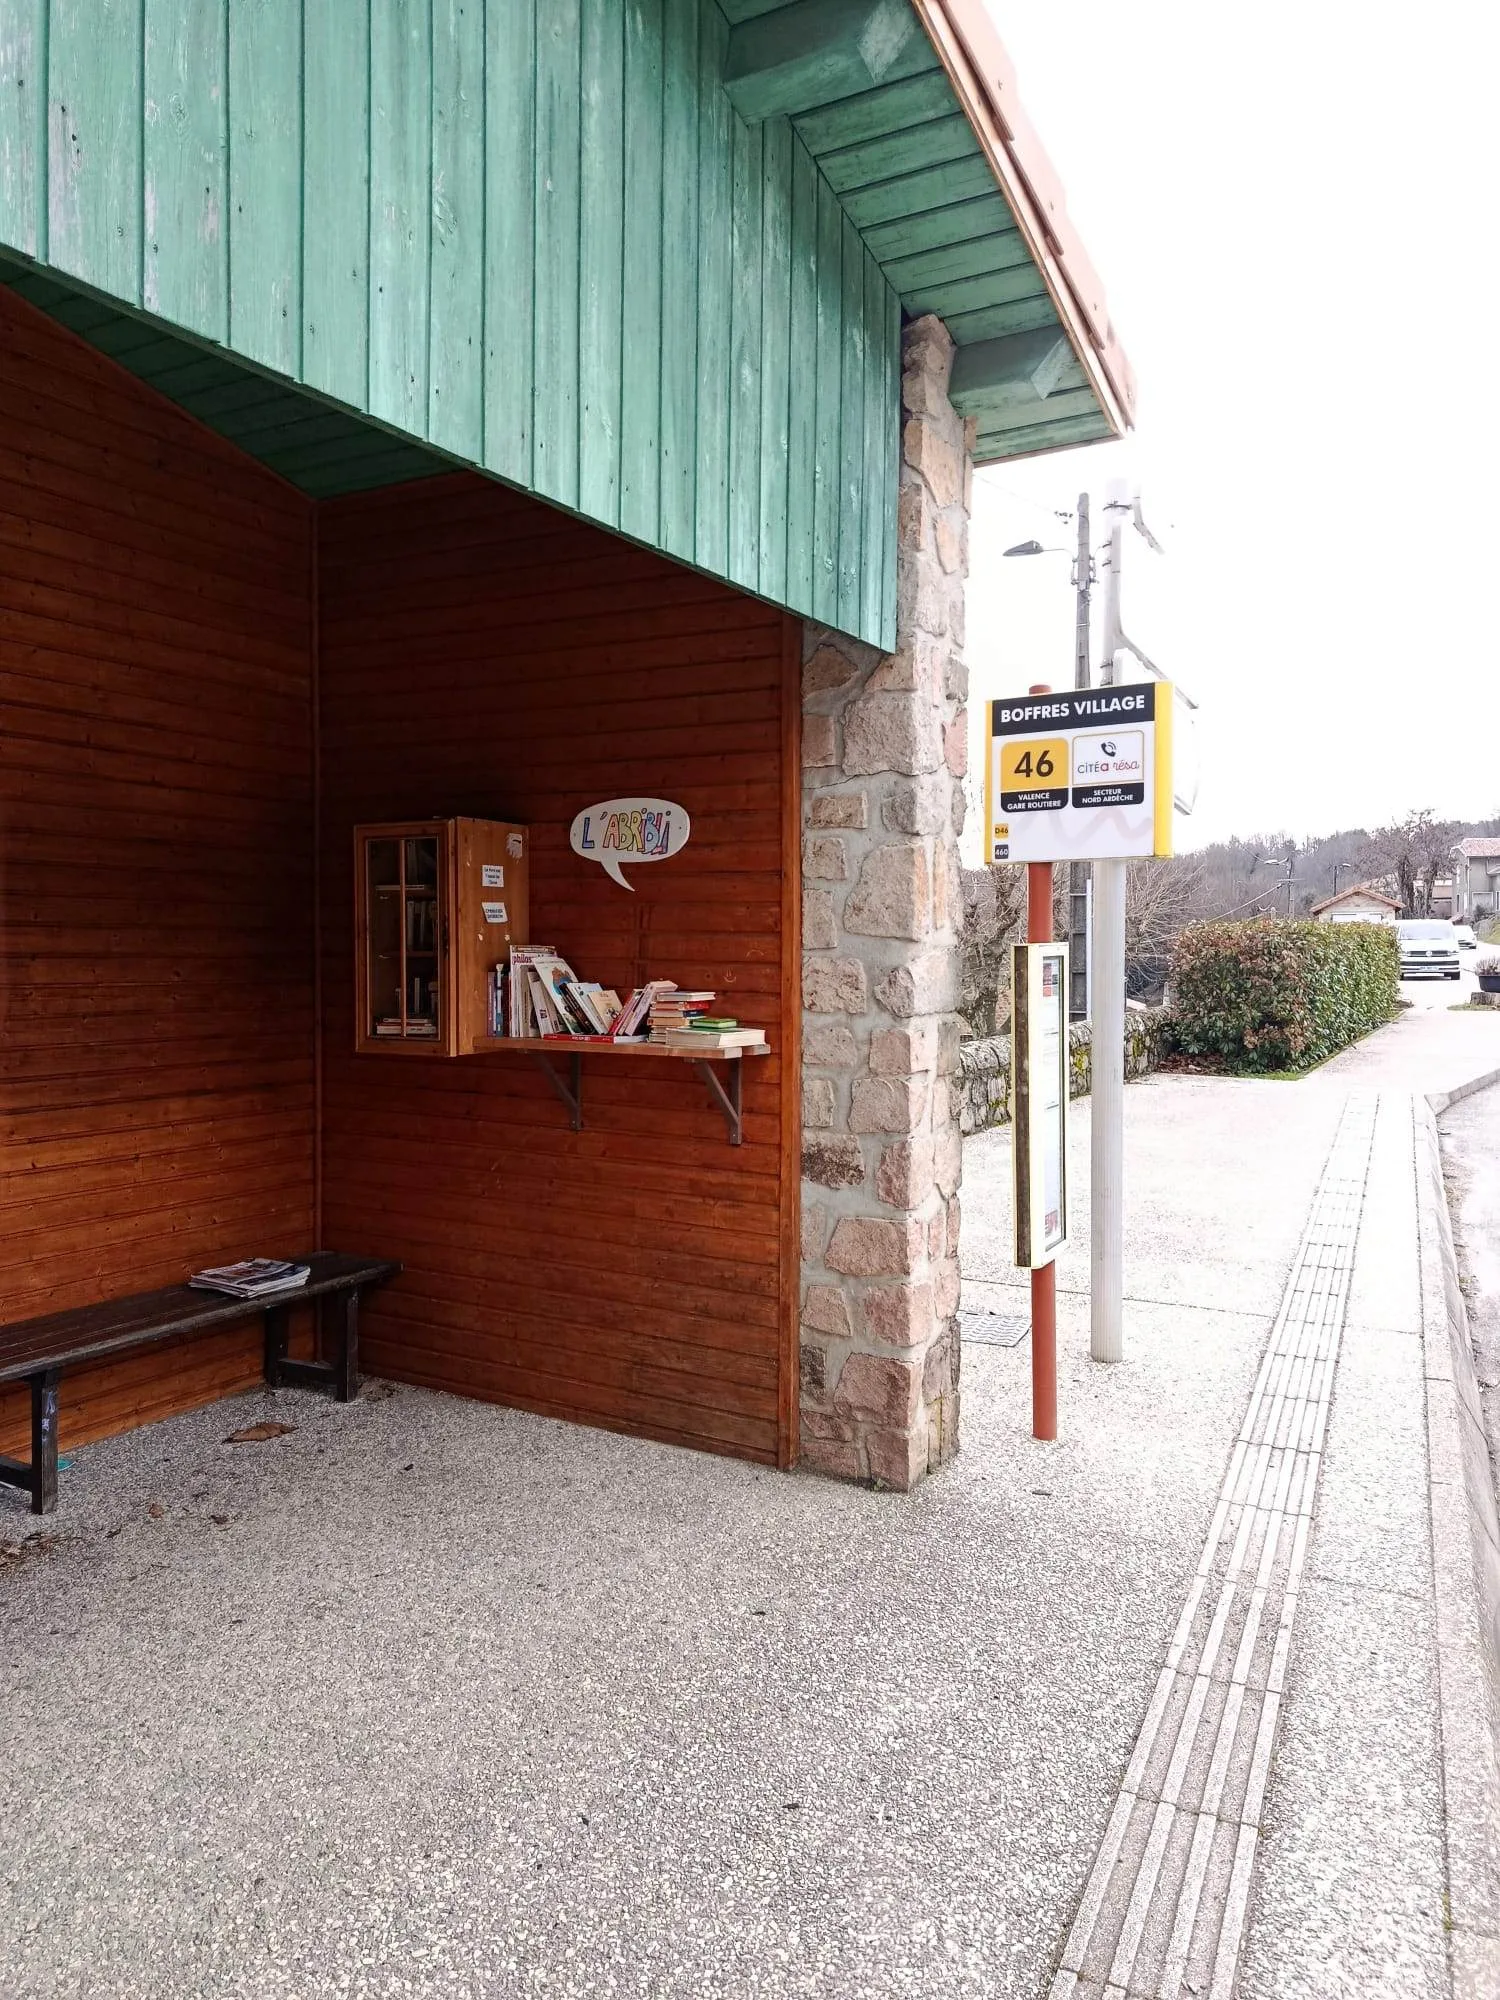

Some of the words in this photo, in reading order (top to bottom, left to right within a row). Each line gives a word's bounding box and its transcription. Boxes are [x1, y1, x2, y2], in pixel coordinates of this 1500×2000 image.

[1001, 702, 1070, 723] BOFFRES
[1074, 695, 1145, 716] VILLAGE
[1014, 750, 1054, 778] 46
[1093, 788, 1122, 796] SECTEUR
[1018, 792, 1050, 801] VALENCE
[1082, 796, 1102, 804] NORD
[1007, 802, 1026, 810] GARE
[995, 848, 1009, 856] 460
